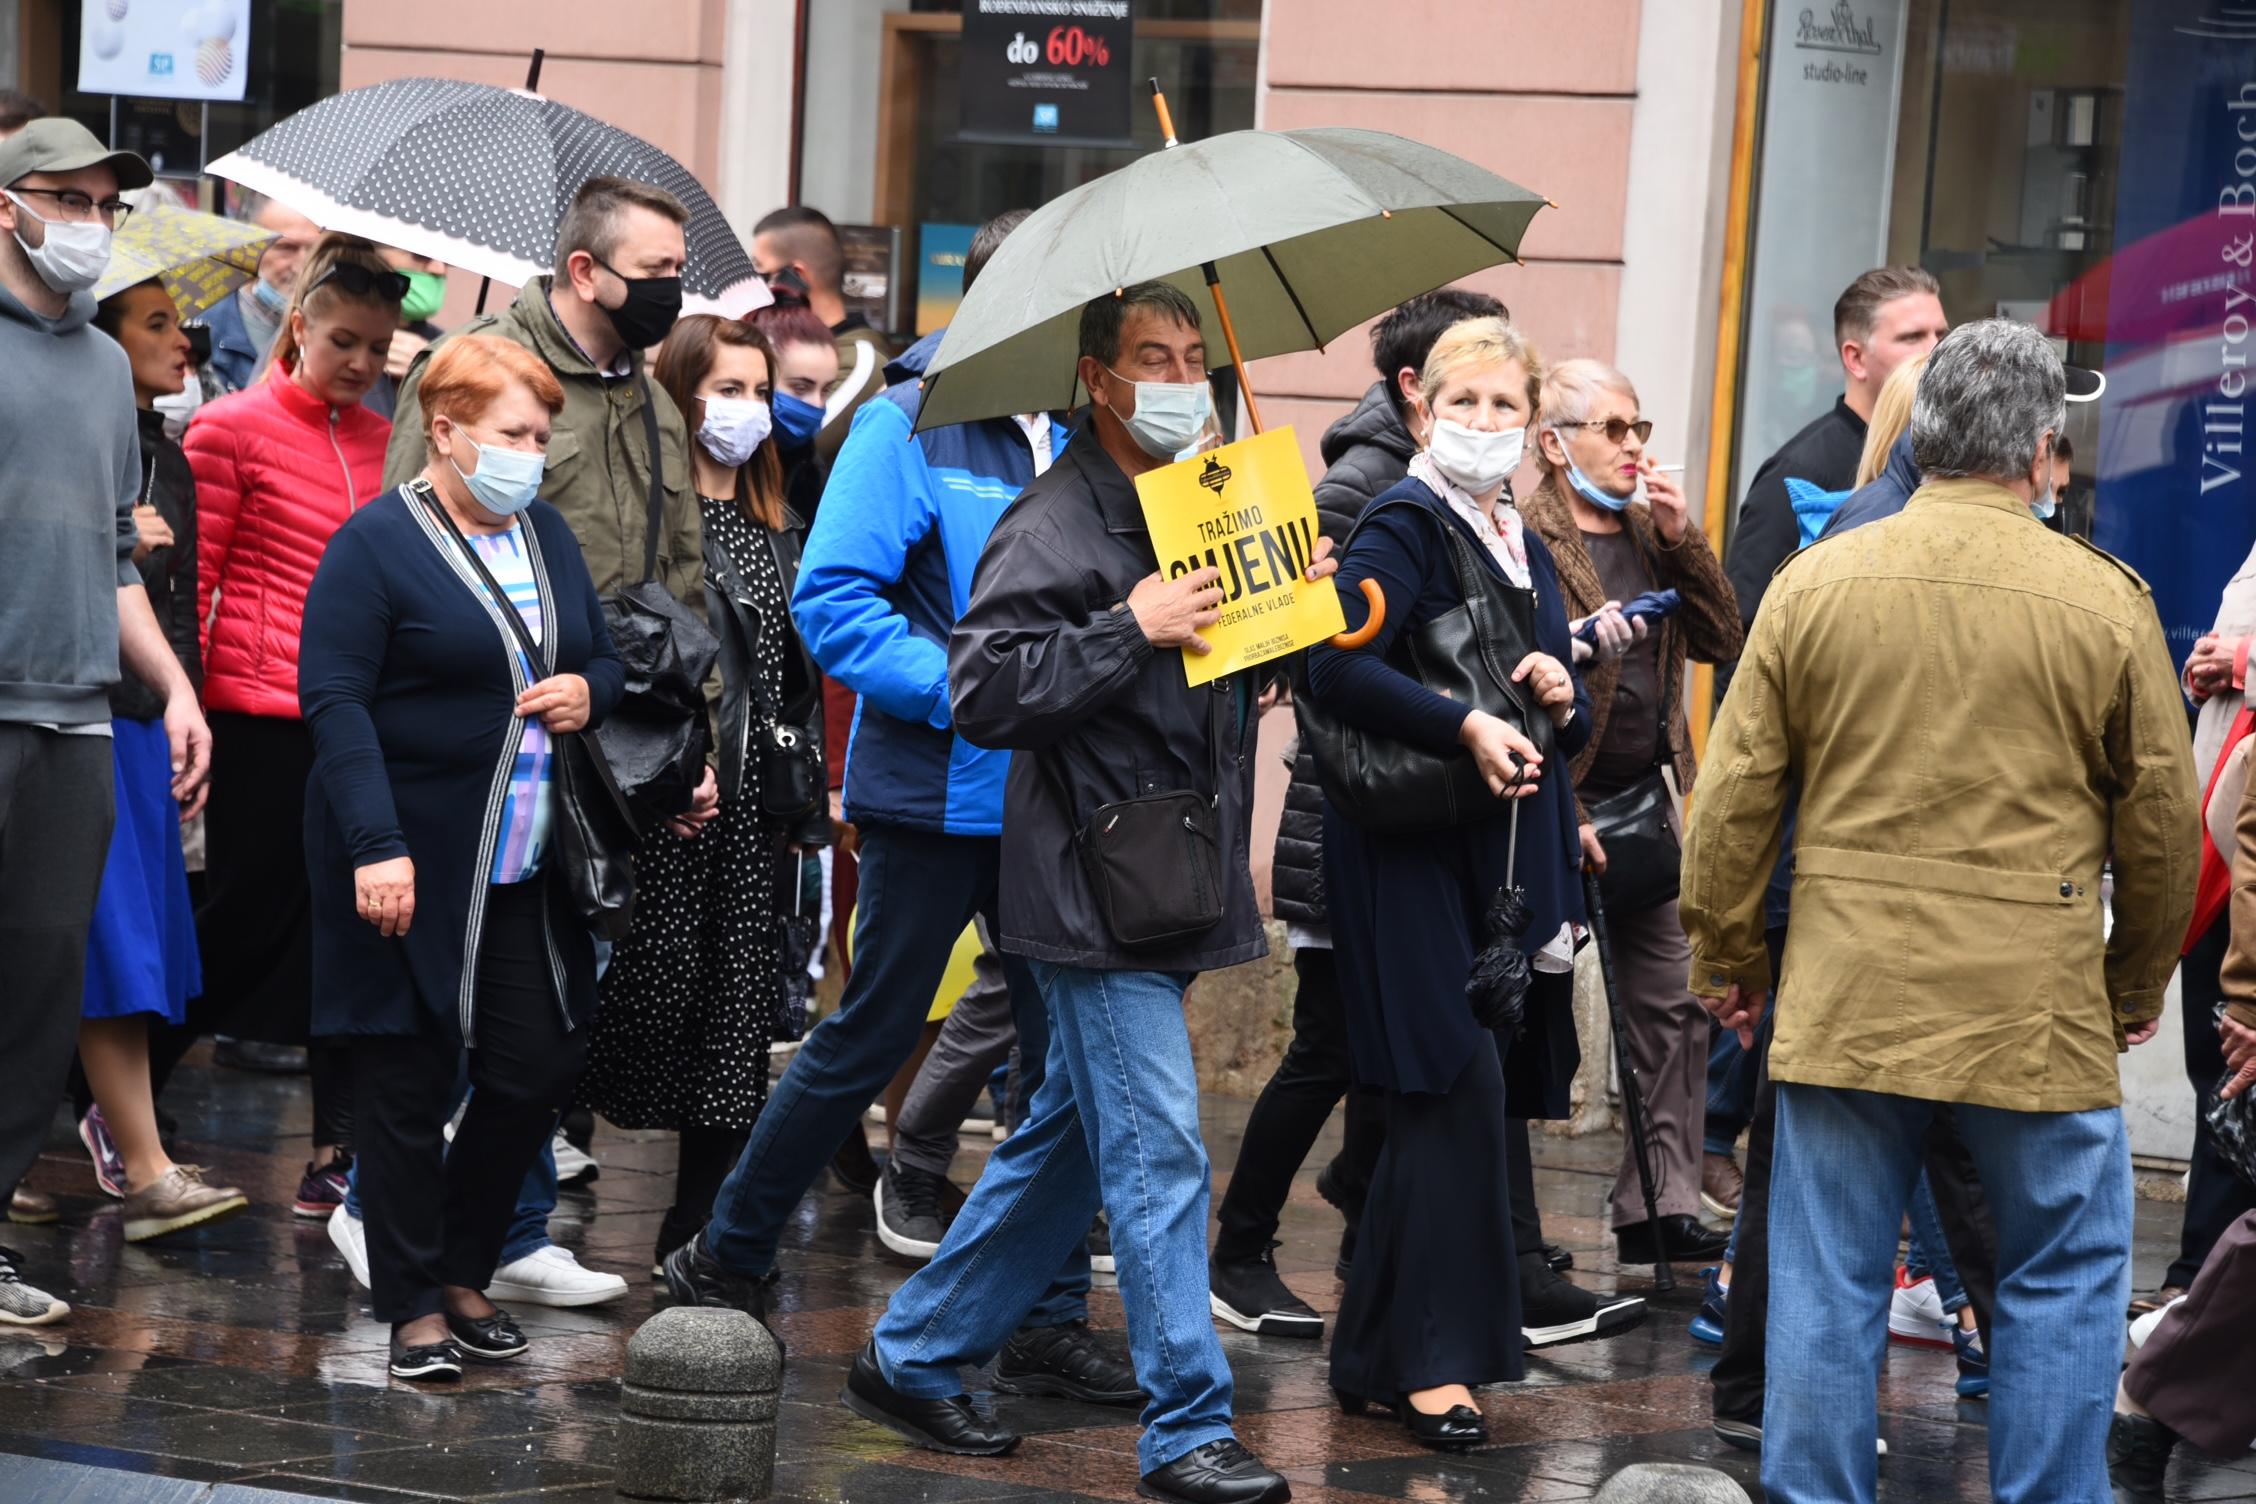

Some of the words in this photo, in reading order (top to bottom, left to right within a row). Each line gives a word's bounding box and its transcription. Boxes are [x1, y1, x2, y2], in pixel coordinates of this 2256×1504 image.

[1007, 31, 1039, 64] do
[1046, 25, 1111, 66] 60%
[2218, 82, 2256, 219] Boch
[2222, 234, 2254, 267] &
[2201, 280, 2256, 496] Villeroy
[1197, 505, 1263, 543] TRAŽIMO
[1218, 603, 1264, 629] FEDERALNE
[1266, 592, 1296, 612] VLADE
